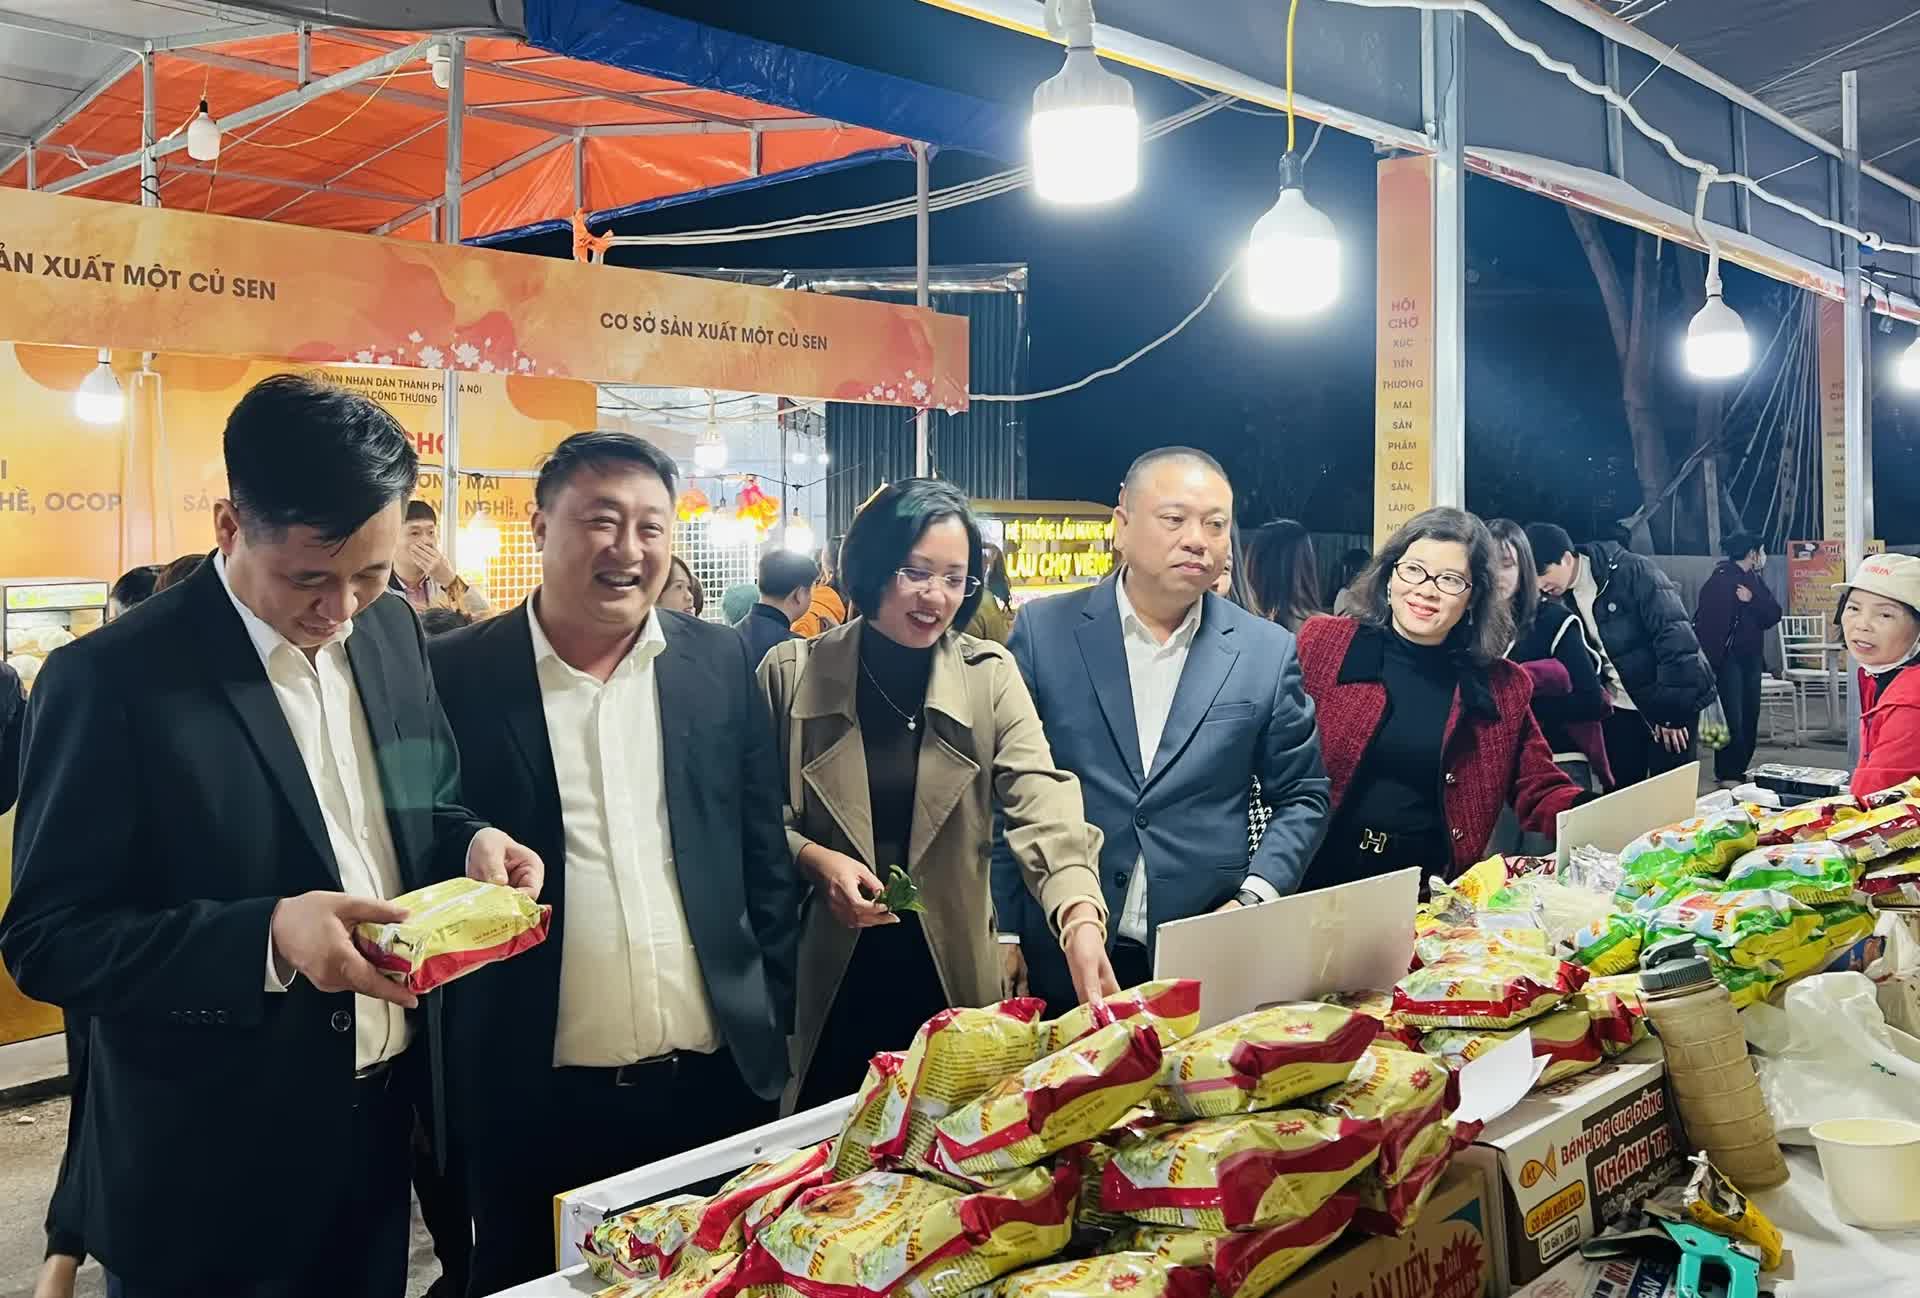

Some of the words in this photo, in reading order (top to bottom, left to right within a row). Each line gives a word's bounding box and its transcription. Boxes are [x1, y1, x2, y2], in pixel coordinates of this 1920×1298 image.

[0, 242, 33, 273] ẢN
[43, 253, 115, 282] XUẤT
[124, 263, 181, 292] MỘT
[188, 268, 225, 294] CỦ
[232, 277, 276, 300] SEN
[600, 312, 628, 330] CƠ
[632, 311, 656, 333] SỞ
[660, 315, 693, 337] SẢN
[697, 320, 737, 342] XUẤT
[741, 325, 774, 346] MỘT
[777, 328, 799, 348] CỦ
[802, 335, 828, 351] SEN
[432, 381, 445, 392] PH
[45, 492, 122, 512] OCOP
[1560, 1129, 1595, 1167] BÁNH
[1611, 1109, 1634, 1138] CUA
[1593, 1136, 1650, 1196] KHÁNH
